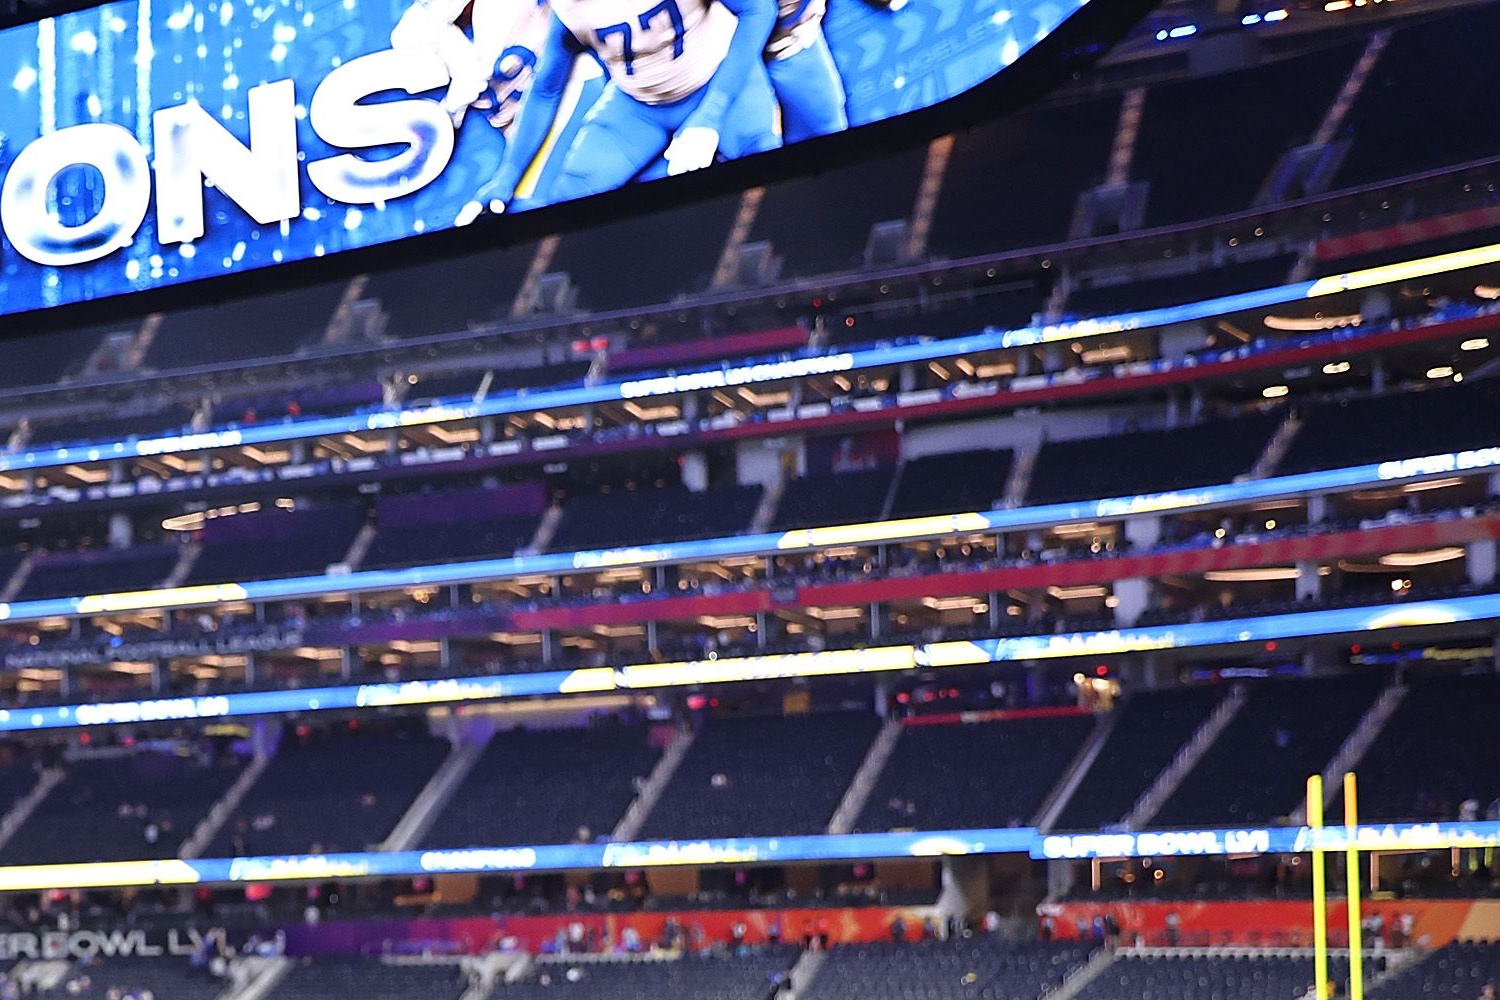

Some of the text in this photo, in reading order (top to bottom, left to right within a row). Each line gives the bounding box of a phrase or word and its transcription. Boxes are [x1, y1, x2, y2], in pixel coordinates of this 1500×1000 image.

[594, 0, 684, 76] 77
[1043, 829, 1270, 858] SUPER BOWL LVI
[42, 929, 164, 959] BOWL
